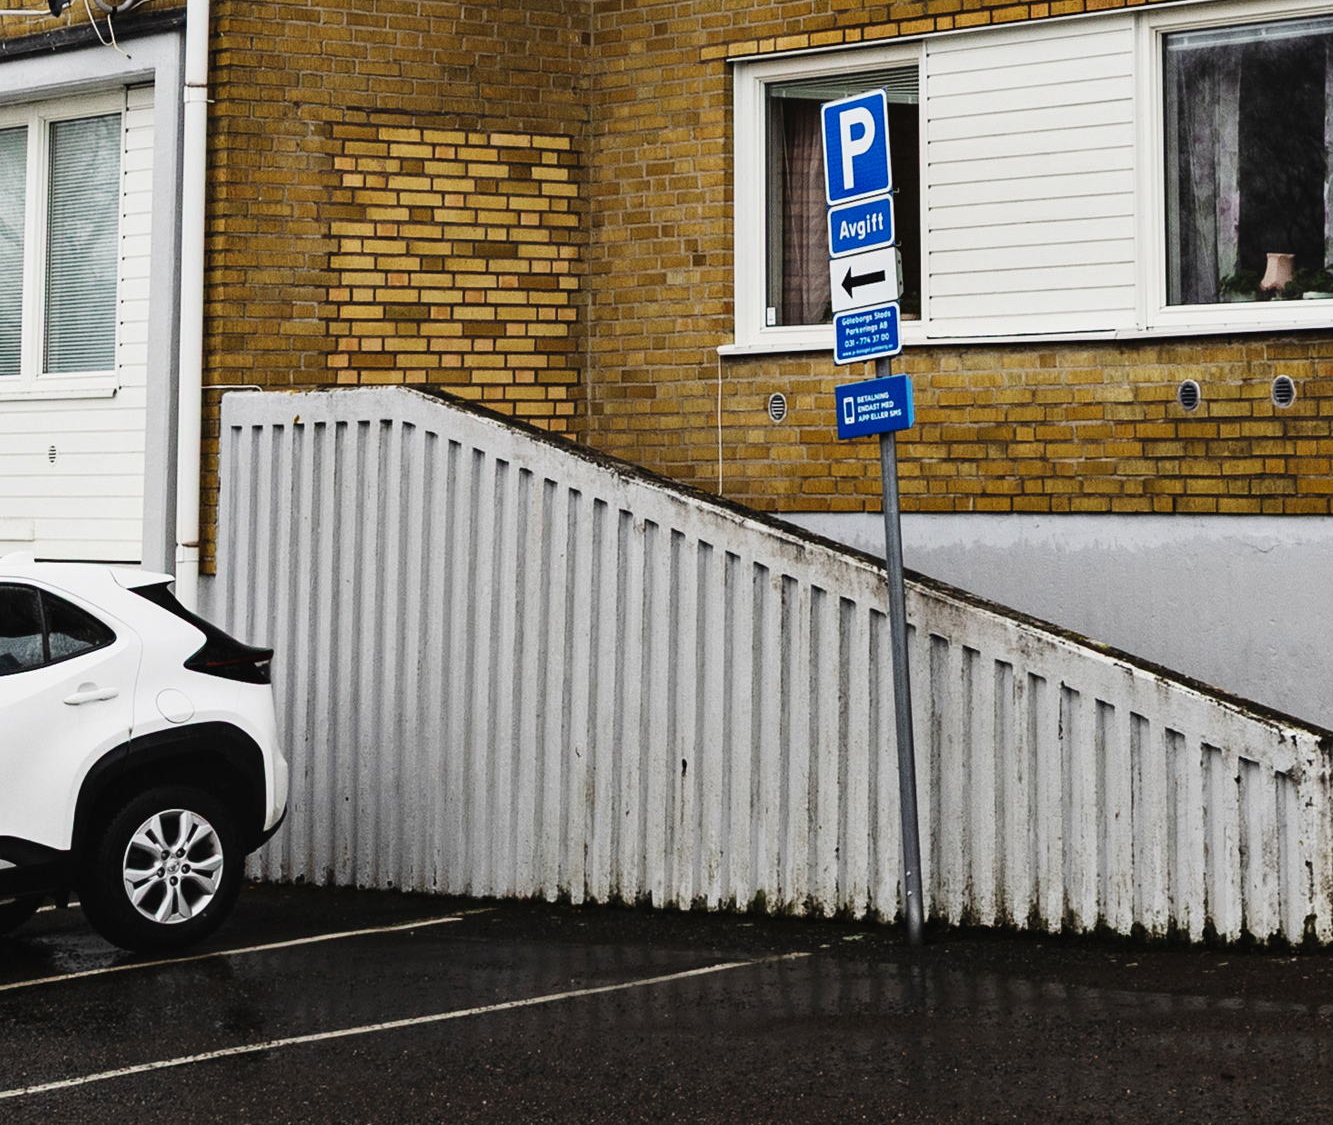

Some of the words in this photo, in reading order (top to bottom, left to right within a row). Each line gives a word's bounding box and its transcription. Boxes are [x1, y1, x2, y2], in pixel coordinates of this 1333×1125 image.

[838, 106, 876, 191] P
[838, 211, 885, 241] Avgift
[841, 314, 873, 326] Göteborgs
[874, 309, 892, 320] Stads
[845, 324, 878, 336] Parkerings
[879, 320, 889, 330] AB
[844, 338, 855, 348] 031
[860, 335, 871, 345] 774
[872, 333, 880, 343] 37
[881, 332, 890, 341] 00
[857, 391, 889, 404] BETALNING
[857, 402, 880, 414] ENDAST
[881, 400, 894, 410] MED
[858, 413, 870, 423] APP
[870, 410, 889, 421] ELLER
[890, 408, 902, 418] SMS
